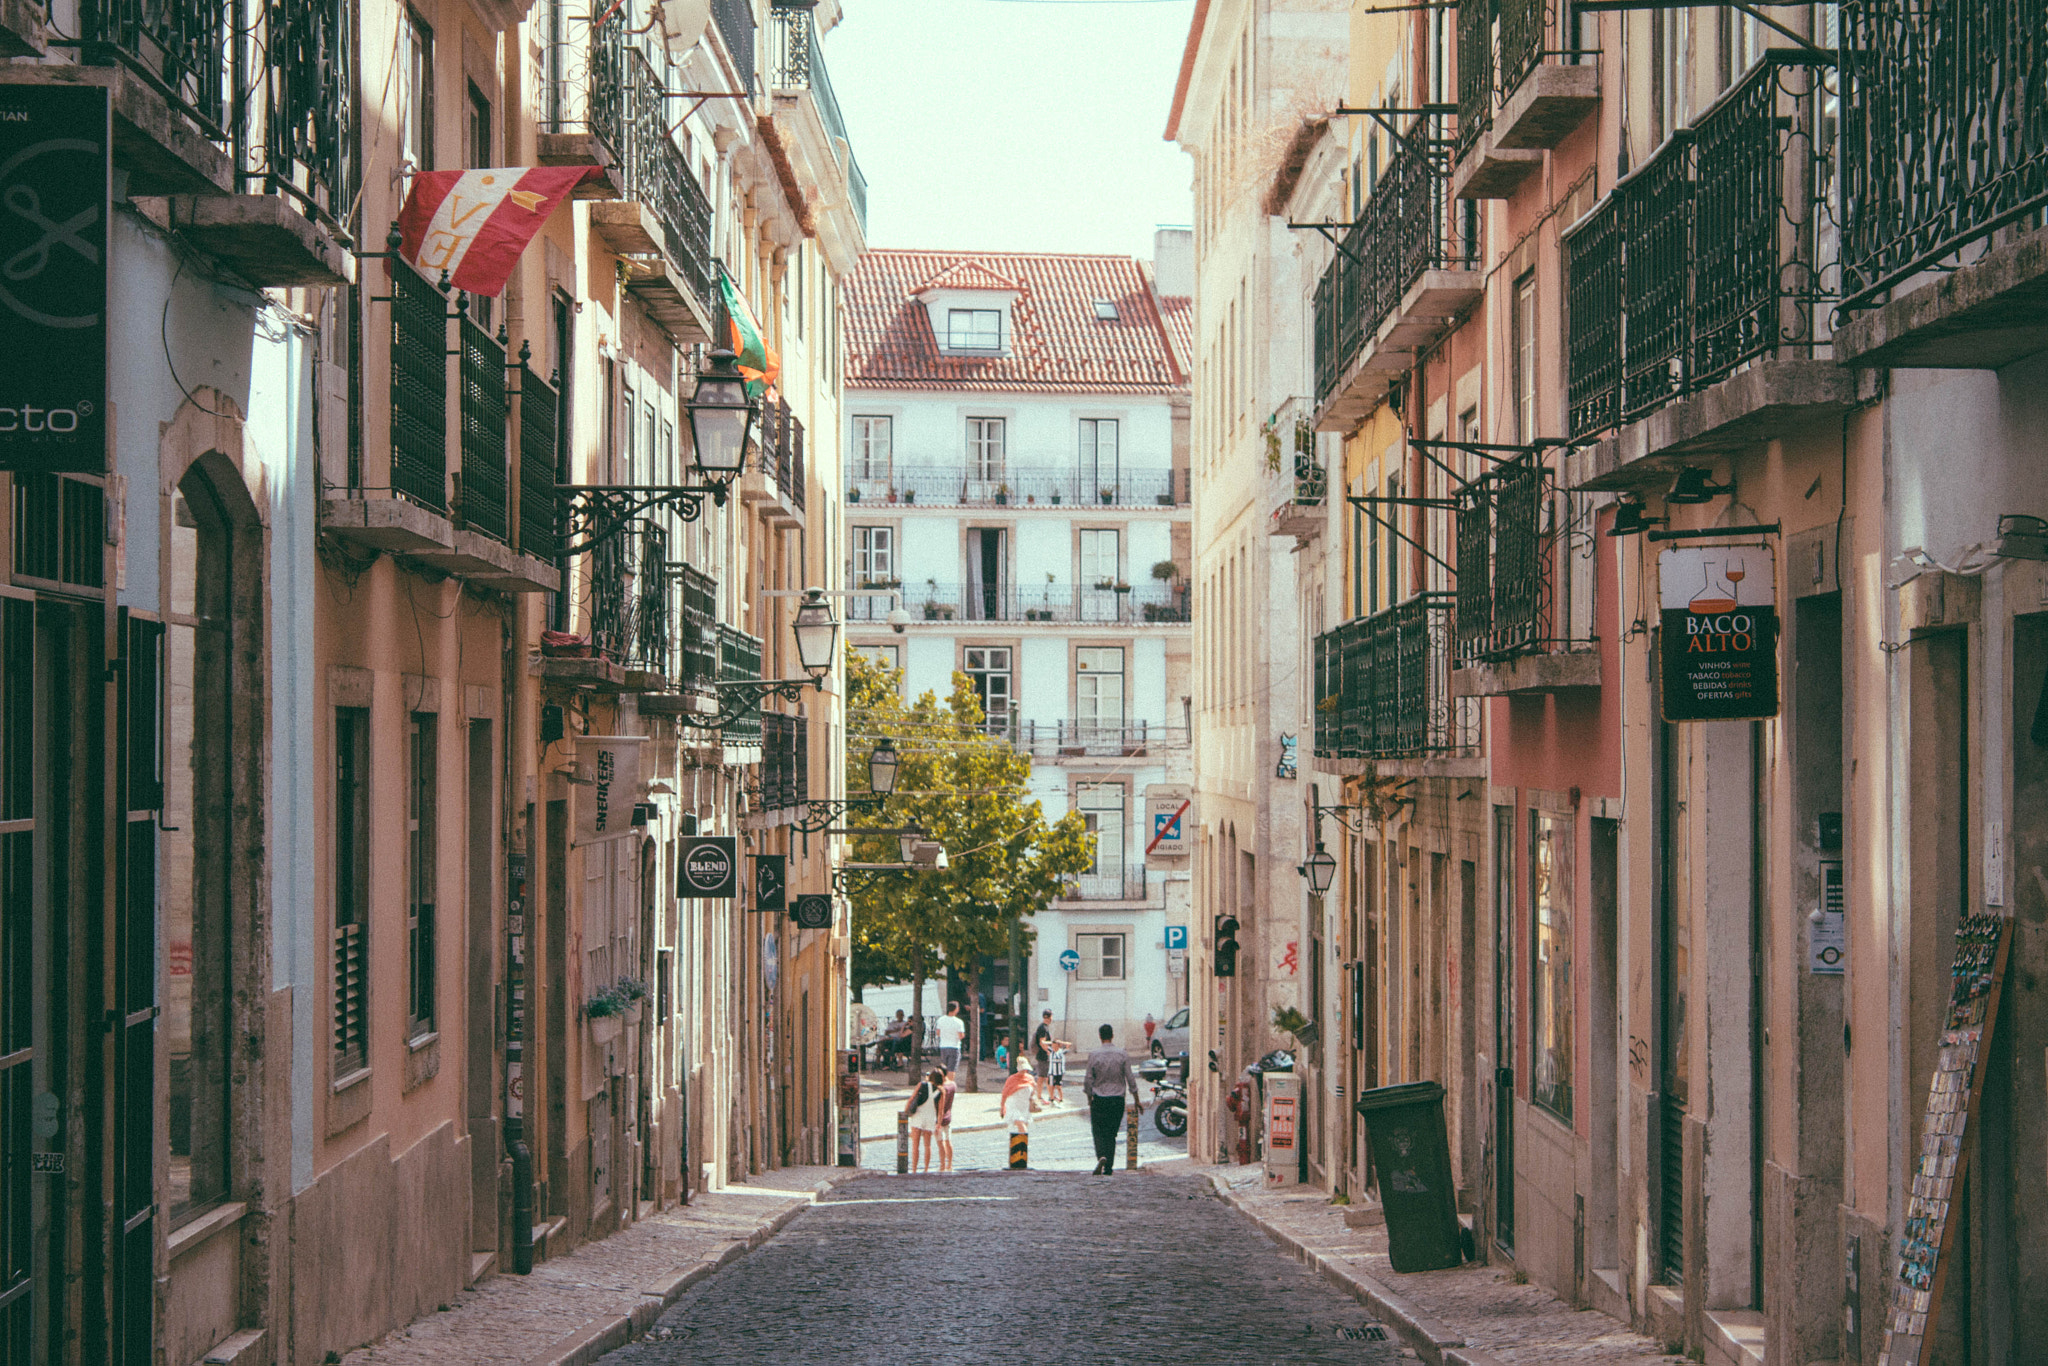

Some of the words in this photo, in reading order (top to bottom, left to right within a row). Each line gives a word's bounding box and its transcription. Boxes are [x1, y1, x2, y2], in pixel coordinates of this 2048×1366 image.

[1686, 615, 1751, 634] BACO
[1687, 632, 1751, 653] ALTO
[1698, 661, 1731, 670] VINHOS
[1688, 672, 1720, 680] TABACO
[1721, 671, 1751, 679] tobacco
[1693, 681, 1727, 690] BEBIDAS
[1728, 681, 1752, 689] drinks
[1697, 691, 1733, 700] OFERTAS
[1734, 691, 1752, 700] gifts
[596, 749, 610, 832] SNEAKERS
[689, 861, 727, 871] BLEND
[1169, 928, 1183, 947] P
